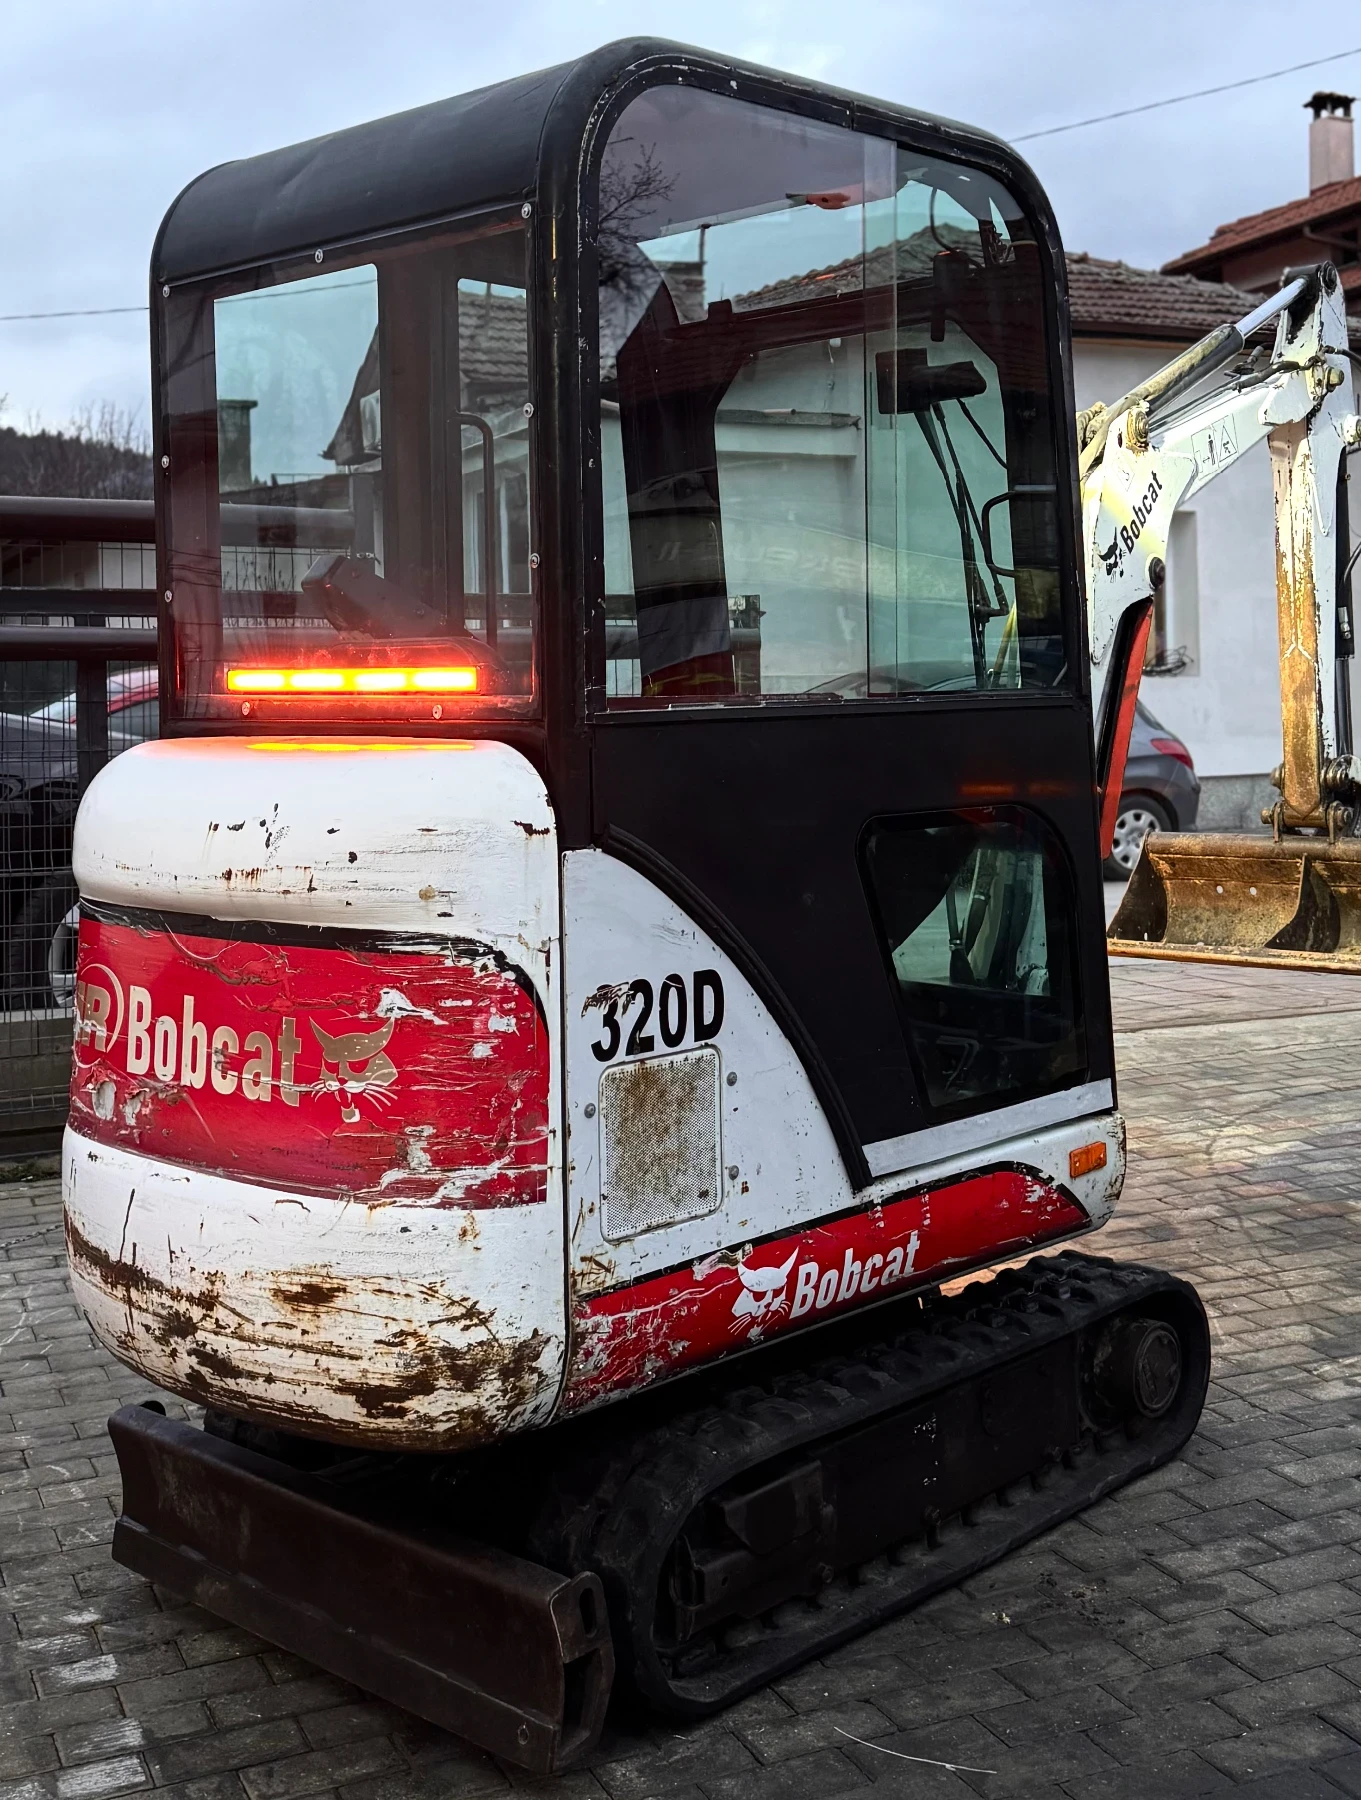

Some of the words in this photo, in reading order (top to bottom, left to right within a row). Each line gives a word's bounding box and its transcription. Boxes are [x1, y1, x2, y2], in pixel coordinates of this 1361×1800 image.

[1119, 470, 1163, 554] Bobcat
[126, 985, 302, 1107] Bobcat
[580, 968, 725, 1063] 320D
[789, 1229, 921, 1320] Bobcat
